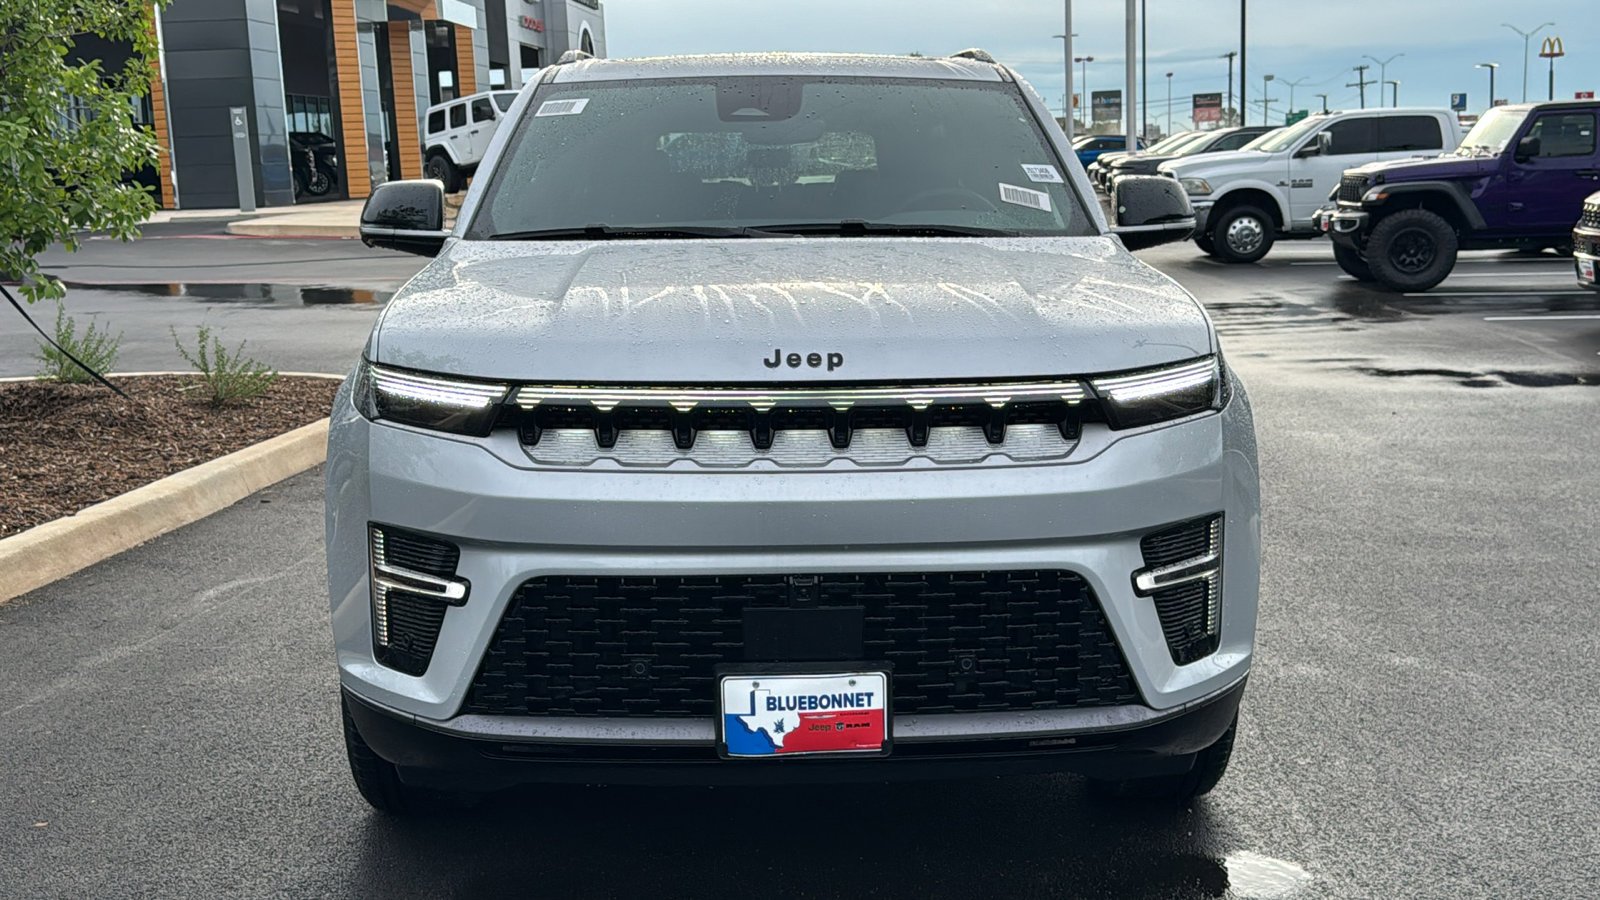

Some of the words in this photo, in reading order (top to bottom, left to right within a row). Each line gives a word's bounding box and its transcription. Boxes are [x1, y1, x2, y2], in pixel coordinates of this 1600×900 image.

[763, 348, 844, 372] Jeep
[766, 692, 874, 711] BLUEBONNET
[808, 723, 832, 732] Jeep
